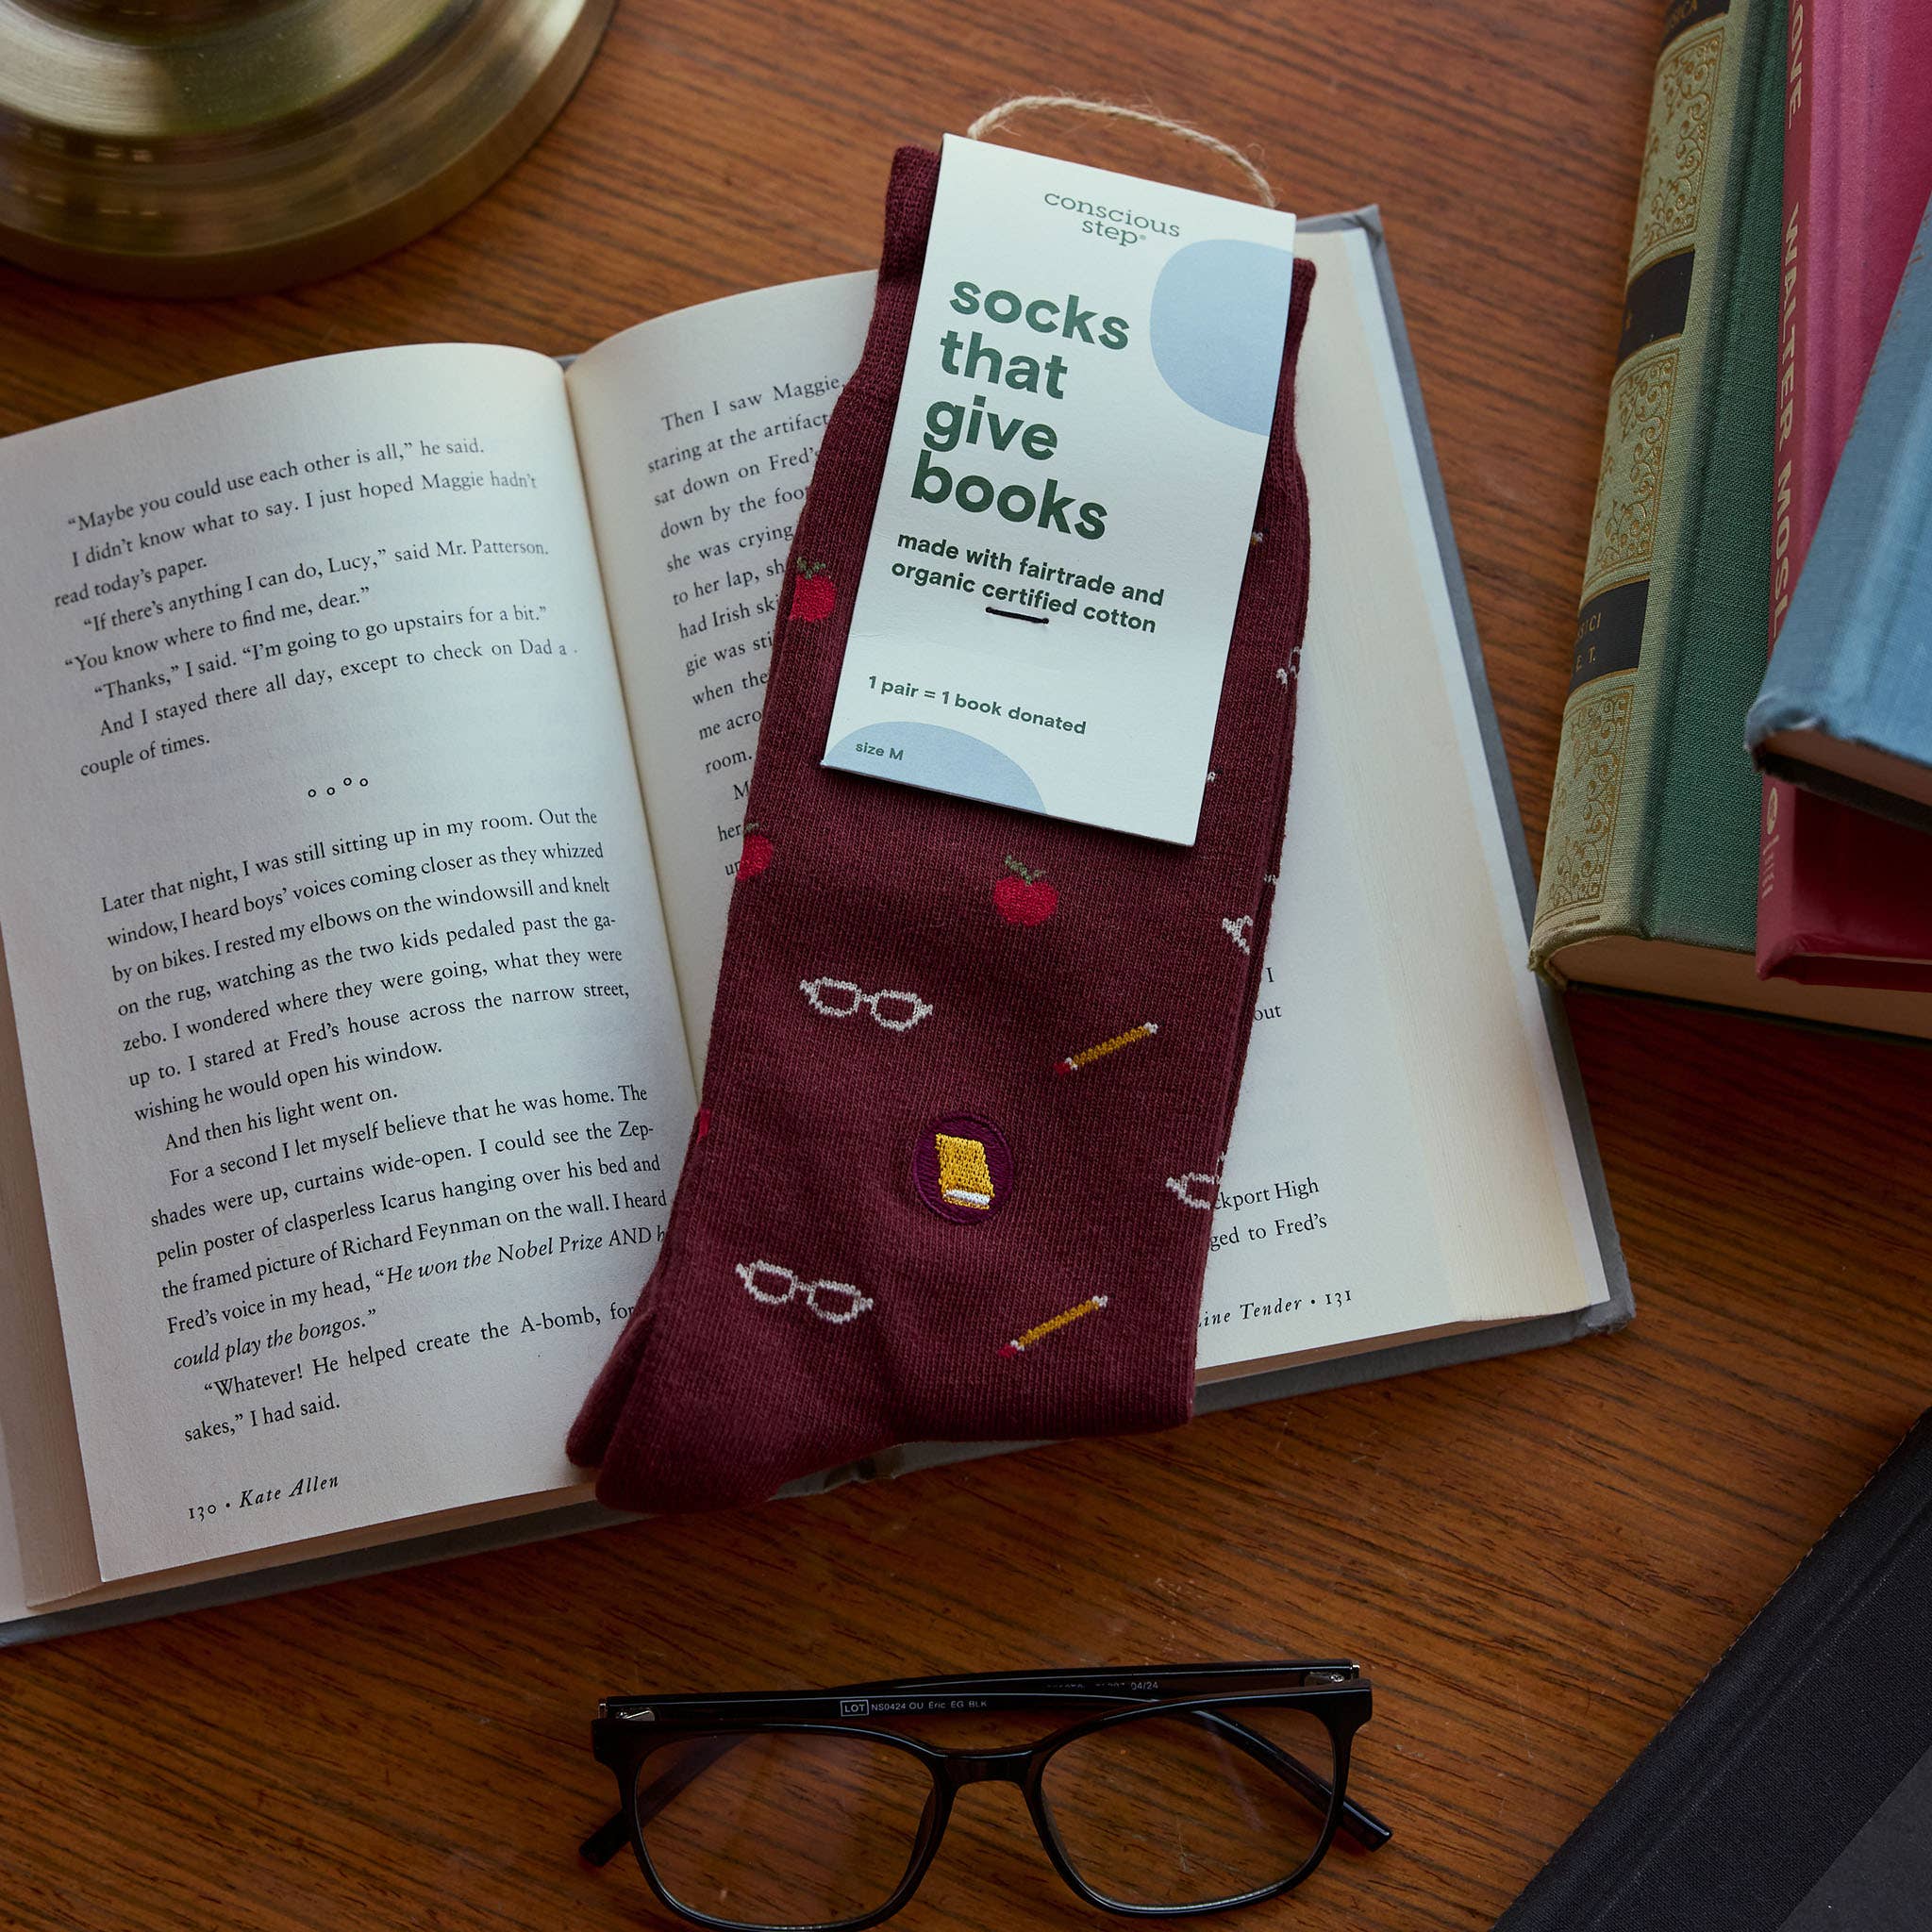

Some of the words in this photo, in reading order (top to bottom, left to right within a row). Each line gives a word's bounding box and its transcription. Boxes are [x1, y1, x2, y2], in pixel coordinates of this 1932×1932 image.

[1789, 0, 1803, 129] OVE
[1044, 192, 1181, 238] conscious
[949, 281, 1130, 350] socks
[1779, 202, 1800, 452] WALTER
[941, 331, 1067, 399] that
[660, 409, 704, 431] Then
[712, 400, 720, 416] I
[729, 393, 762, 411] saw
[923, 395, 1058, 460] give
[648, 445, 702, 474] staring
[707, 439, 724, 453] at
[729, 428, 757, 446] the
[139, 497, 171, 518] you
[175, 477, 222, 504] could
[226, 475, 254, 491] use
[259, 460, 299, 483] each
[304, 454, 350, 473] other
[357, 449, 371, 464] is
[420, 440, 440, 456] he
[446, 438, 484, 454] said.
[654, 489, 675, 506] sat
[683, 473, 729, 495] down
[738, 464, 760, 478] on
[910, 451, 1108, 540] books
[72, 551, 79, 568] I
[139, 526, 186, 549] know
[192, 513, 235, 534] what
[241, 509, 258, 523] to
[265, 501, 299, 517] say.
[305, 491, 313, 508] I
[320, 489, 352, 509] just
[358, 475, 414, 499] hoped
[421, 474, 483, 491] Maggie
[660, 515, 704, 539] down
[709, 506, 730, 523] by
[739, 495, 767, 513] the
[774, 487, 808, 504] foo
[667, 554, 691, 573] she
[697, 541, 730, 560] was
[739, 525, 793, 549] crying
[898, 535, 958, 559] made
[967, 548, 1011, 572] with
[1020, 558, 1115, 594] fairtrade
[1122, 586, 1164, 606] and
[55, 582, 91, 608] read
[157, 558, 208, 584] paper.
[673, 591, 689, 606] to
[692, 579, 720, 598] her
[725, 571, 759, 588] lap,
[891, 562, 975, 592] organic
[982, 583, 1076, 615] certified
[1083, 607, 1156, 633] cotton
[678, 614, 708, 639] had
[711, 603, 751, 627] Irish
[686, 654, 708, 676] gie
[713, 643, 745, 661] was
[691, 683, 734, 706] when
[741, 671, 766, 690] the
[869, 675, 876, 689] 1
[881, 682, 919, 697] pair
[942, 691, 949, 704] 1
[955, 693, 1002, 716] book
[1008, 707, 1086, 734] donated
[80, 749, 134, 776] couple
[139, 740, 157, 761] of
[160, 734, 209, 756] times.
[699, 723, 722, 741] me
[855, 741, 884, 757] size
[890, 747, 904, 760] M
[705, 751, 753, 774] room.
[717, 824, 741, 842] her
[101, 891, 145, 913] Later
[150, 881, 185, 900] that
[189, 867, 239, 891] night,
[242, 860, 251, 877] I
[255, 856, 289, 874] was
[294, 841, 326, 864] still
[332, 834, 388, 856] sitting
[392, 830, 416, 847] up
[423, 823, 441, 839] in
[446, 821, 474, 837] my
[480, 815, 533, 830] room.
[539, 808, 571, 824] Out
[575, 807, 597, 824] the
[107, 920, 178, 947] window,
[180, 911, 189, 928] I
[191, 898, 241, 926] heard
[291, 879, 346, 902] voices
[350, 864, 418, 888] coming
[421, 856, 473, 874] closer
[477, 853, 497, 866] as
[500, 845, 537, 865] they
[541, 841, 604, 859] whizzed
[1265, 967, 1274, 983] I
[151, 1202, 207, 1227] shades
[211, 1192, 255, 1214] were
[258, 1187, 289, 1204] up,
[294, 1166, 365, 1193] curtains
[370, 1147, 472, 1177] wide-open.
[478, 1138, 488, 1155] I
[494, 1128, 546, 1152] could
[553, 1130, 580, 1144] see
[584, 1122, 613, 1141] the
[618, 1120, 654, 1141] Zep-
[1274, 1176, 1320, 1200] High
[156, 1241, 198, 1268] pelin
[203, 1229, 256, 1257] poster
[260, 1217, 281, 1238] of
[284, 1201, 376, 1232] clasperless
[377, 1190, 436, 1211] Icarus
[441, 1174, 517, 1199] hanging
[522, 1168, 561, 1185] over
[566, 1160, 593, 1179] his
[597, 1155, 630, 1178] bed
[633, 1153, 661, 1174] and
[1248, 1228, 1266, 1241] to
[1274, 1212, 1327, 1236] Fred’s
[1199, 1310, 1231, 1327] ine
[1240, 1298, 1302, 1320] Tender
[1324, 1290, 1351, 1307] 131
[189, 1505, 216, 1522] 130
[240, 1489, 281, 1508] Kate
[289, 1475, 339, 1498] Allen
[844, 1703, 866, 1713] LOT
[872, 1703, 907, 1711] NS0424
[908, 1702, 924, 1710] OU
[928, 1701, 946, 1709] Eric
[950, 1700, 964, 1708] EG
[968, 1700, 988, 1708] BLK
